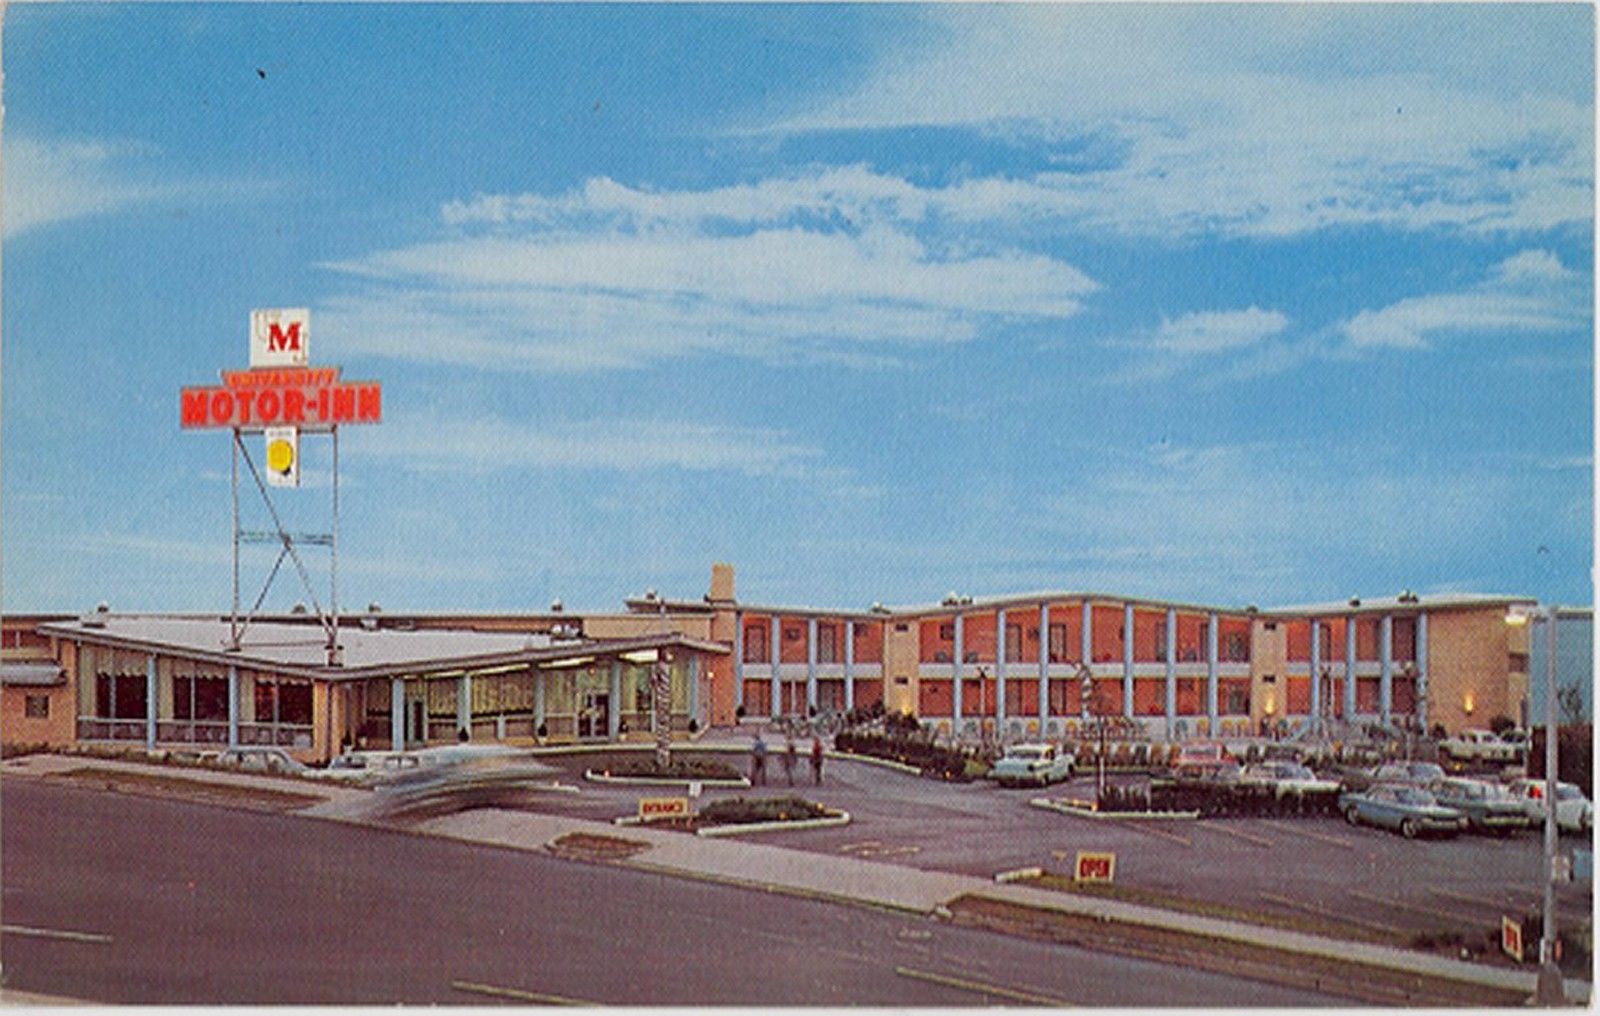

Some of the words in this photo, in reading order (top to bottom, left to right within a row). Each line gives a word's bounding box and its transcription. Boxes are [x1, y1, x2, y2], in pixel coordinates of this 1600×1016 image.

[268, 322, 301, 352] M
[181, 384, 381, 426] MOTOR-INN
[1081, 857, 1109, 877] OPEN
